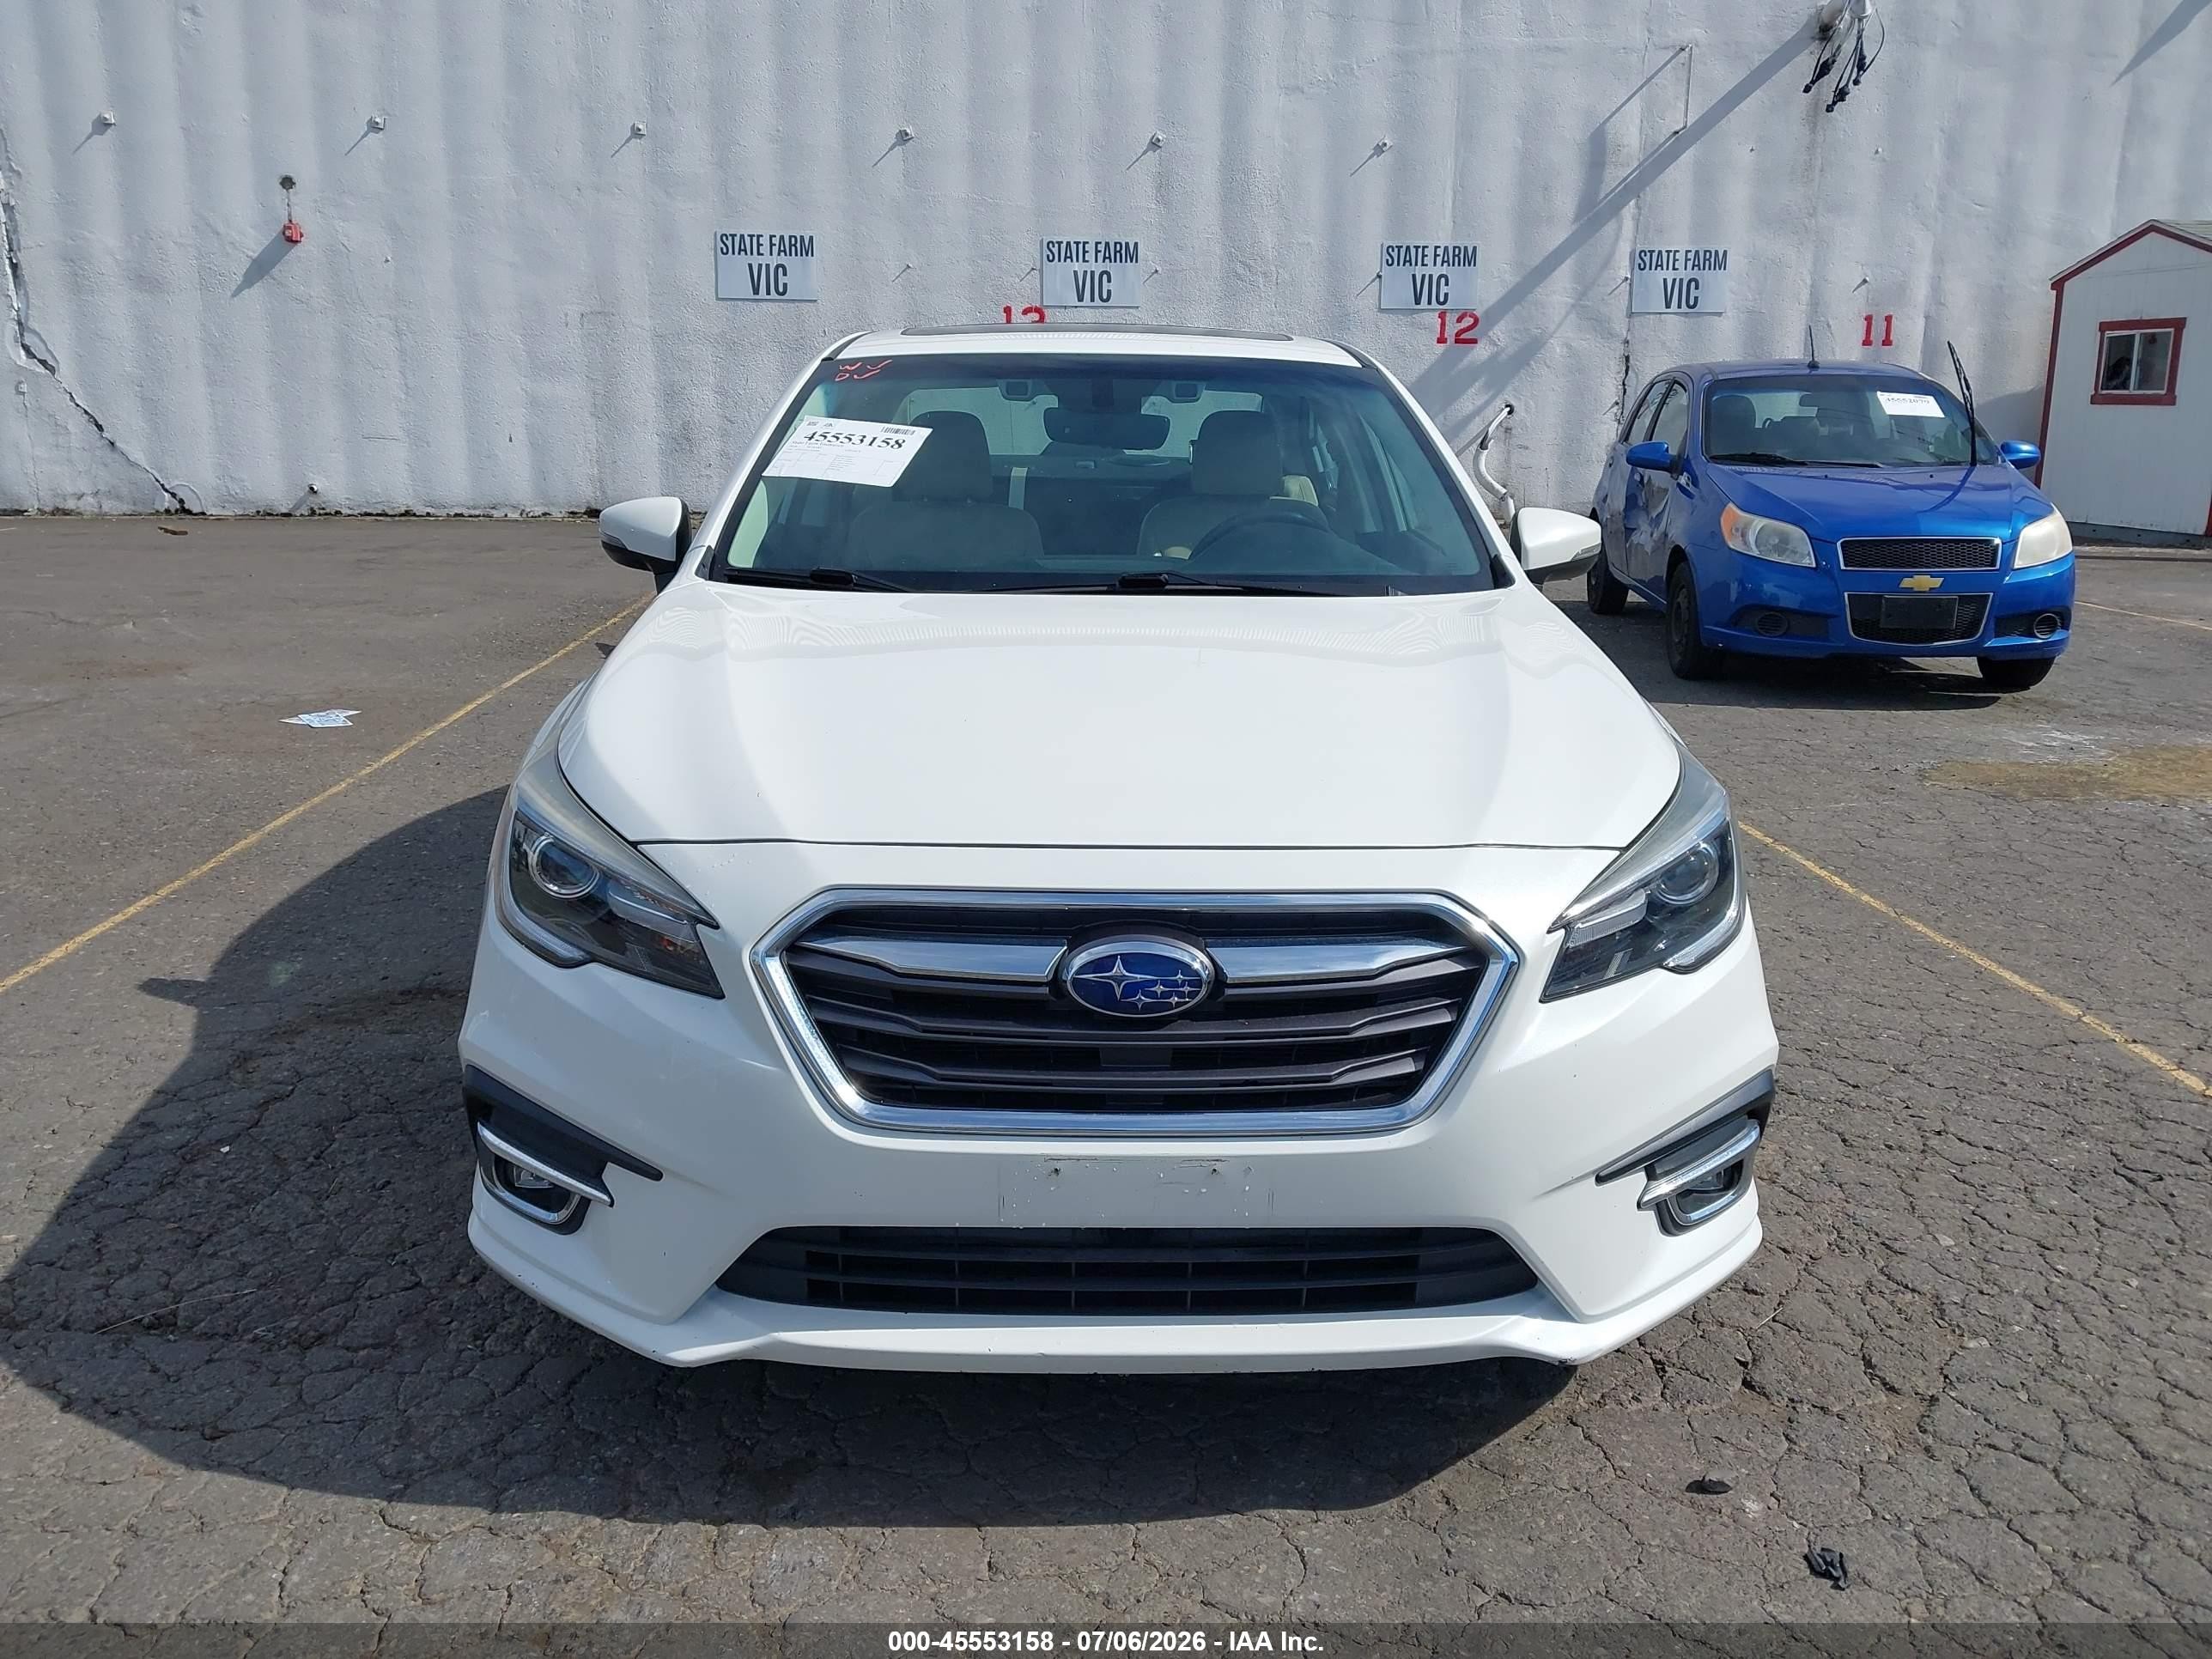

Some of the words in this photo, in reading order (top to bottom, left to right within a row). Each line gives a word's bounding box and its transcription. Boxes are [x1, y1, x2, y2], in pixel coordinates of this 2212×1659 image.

[720, 233, 764, 257] STATE
[769, 234, 815, 258] FARM
[1046, 240, 1091, 264] STATE
[1094, 240, 1139, 264] FARM
[1385, 245, 1430, 267] STATE
[1432, 245, 1476, 268] FARM
[1638, 249, 1680, 271] STATE
[1684, 249, 1727, 271] FARM
[747, 263, 788, 297] VIC
[1073, 270, 1112, 303] VIC
[1411, 273, 1449, 307] VIC
[1662, 277, 1700, 310] VIC
[1436, 312, 1478, 344] 12
[1863, 315, 1893, 345] 11
[804, 430, 905, 449] 45553158
